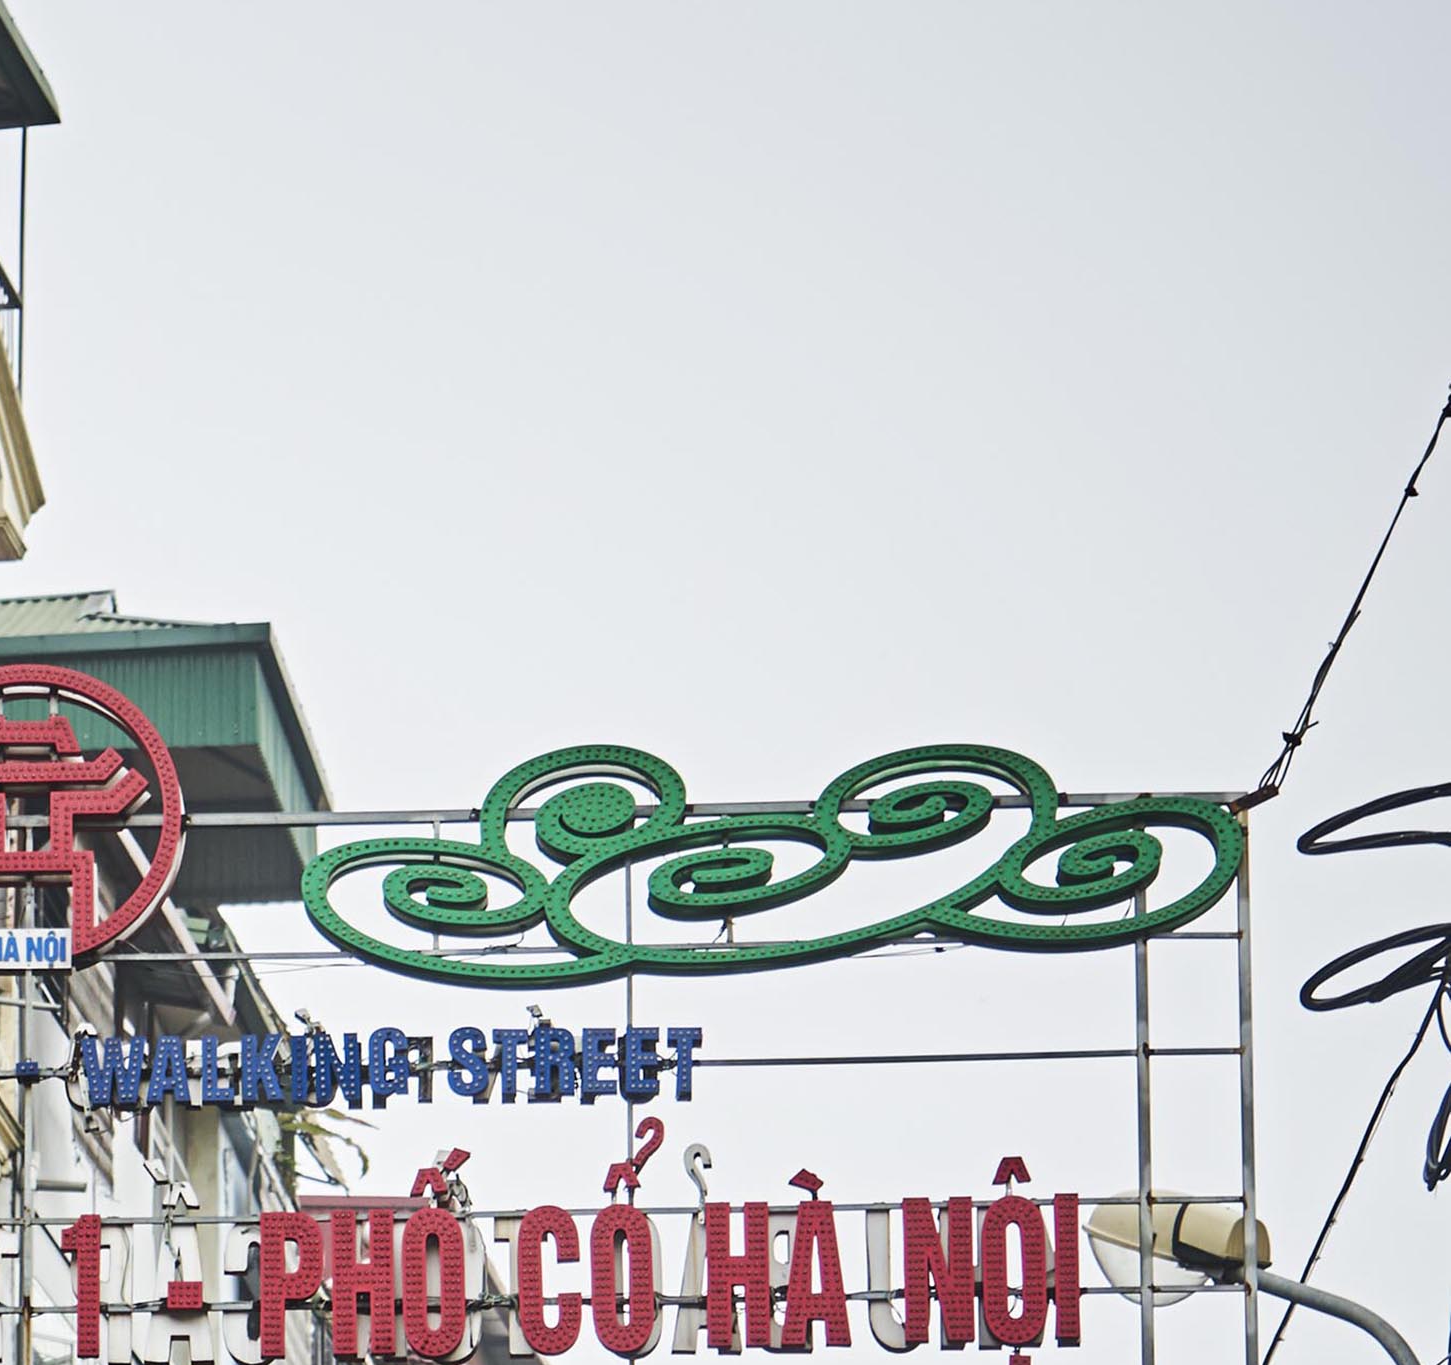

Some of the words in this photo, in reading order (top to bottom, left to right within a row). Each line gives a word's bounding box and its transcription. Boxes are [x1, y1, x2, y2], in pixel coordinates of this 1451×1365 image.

[25, 928, 67, 964] NỘI
[80, 1026, 410, 1101] WALKING
[450, 1026, 703, 1101] STREET
[61, 1212, 102, 1360] 1
[259, 1146, 468, 1360] PHỐ
[516, 1115, 665, 1357] CỔ
[704, 1167, 852, 1350] HÀ
